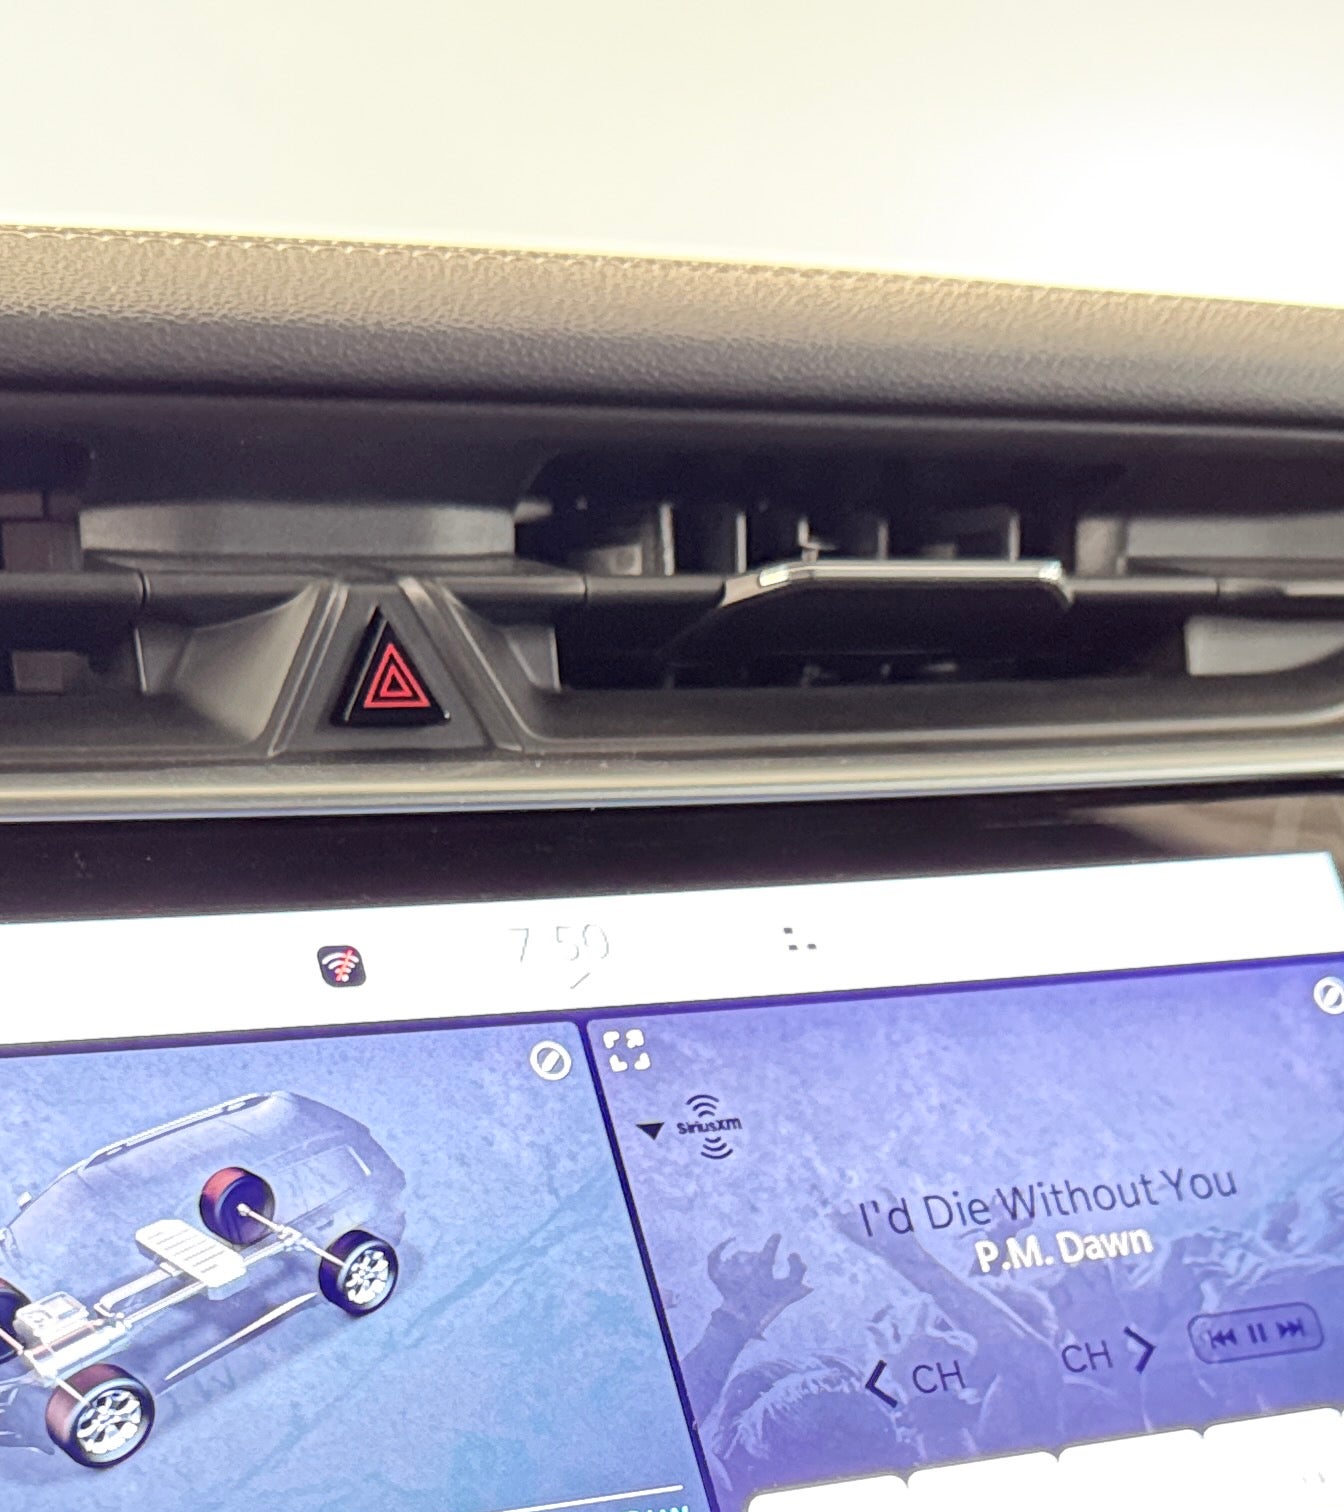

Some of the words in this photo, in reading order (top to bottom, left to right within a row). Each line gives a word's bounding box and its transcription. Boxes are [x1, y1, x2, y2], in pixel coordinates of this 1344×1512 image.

[858, 1197, 915, 1238] I'd
[924, 1190, 990, 1231] Die
[996, 1172, 1159, 1221] Without
[1159, 1167, 1238, 1202] You
[973, 1238, 1054, 1274] P.M.
[1056, 1226, 1155, 1264] Dawn
[1060, 1339, 1113, 1374] CH
[911, 1360, 967, 1395] CH
